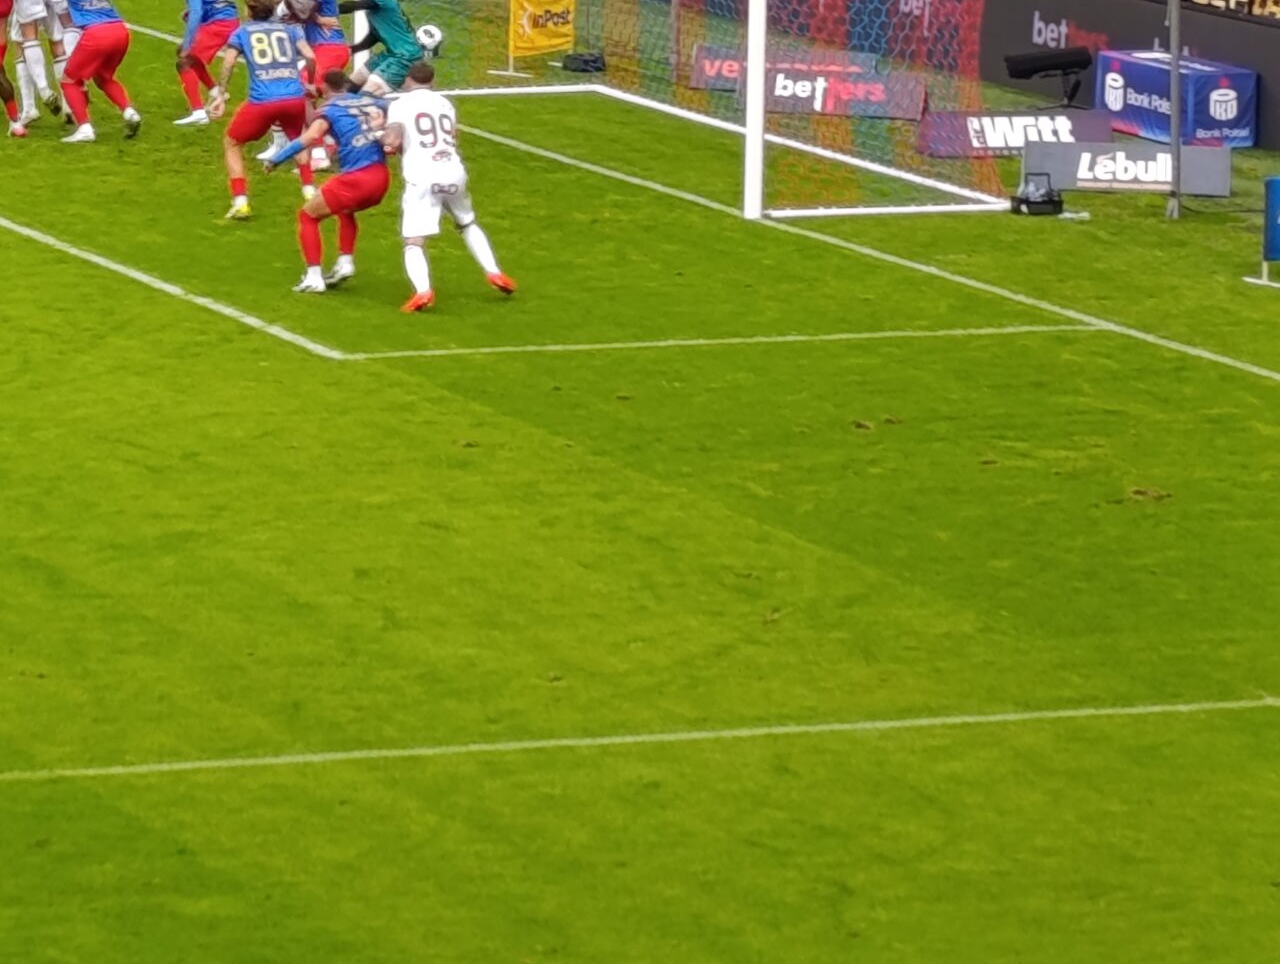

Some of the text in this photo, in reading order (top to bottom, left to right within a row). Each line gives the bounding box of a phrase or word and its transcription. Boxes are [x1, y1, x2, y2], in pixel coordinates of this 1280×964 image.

[532, 8, 570, 28] InPost
[250, 31, 293, 65] 80
[415, 112, 456, 148] 99
